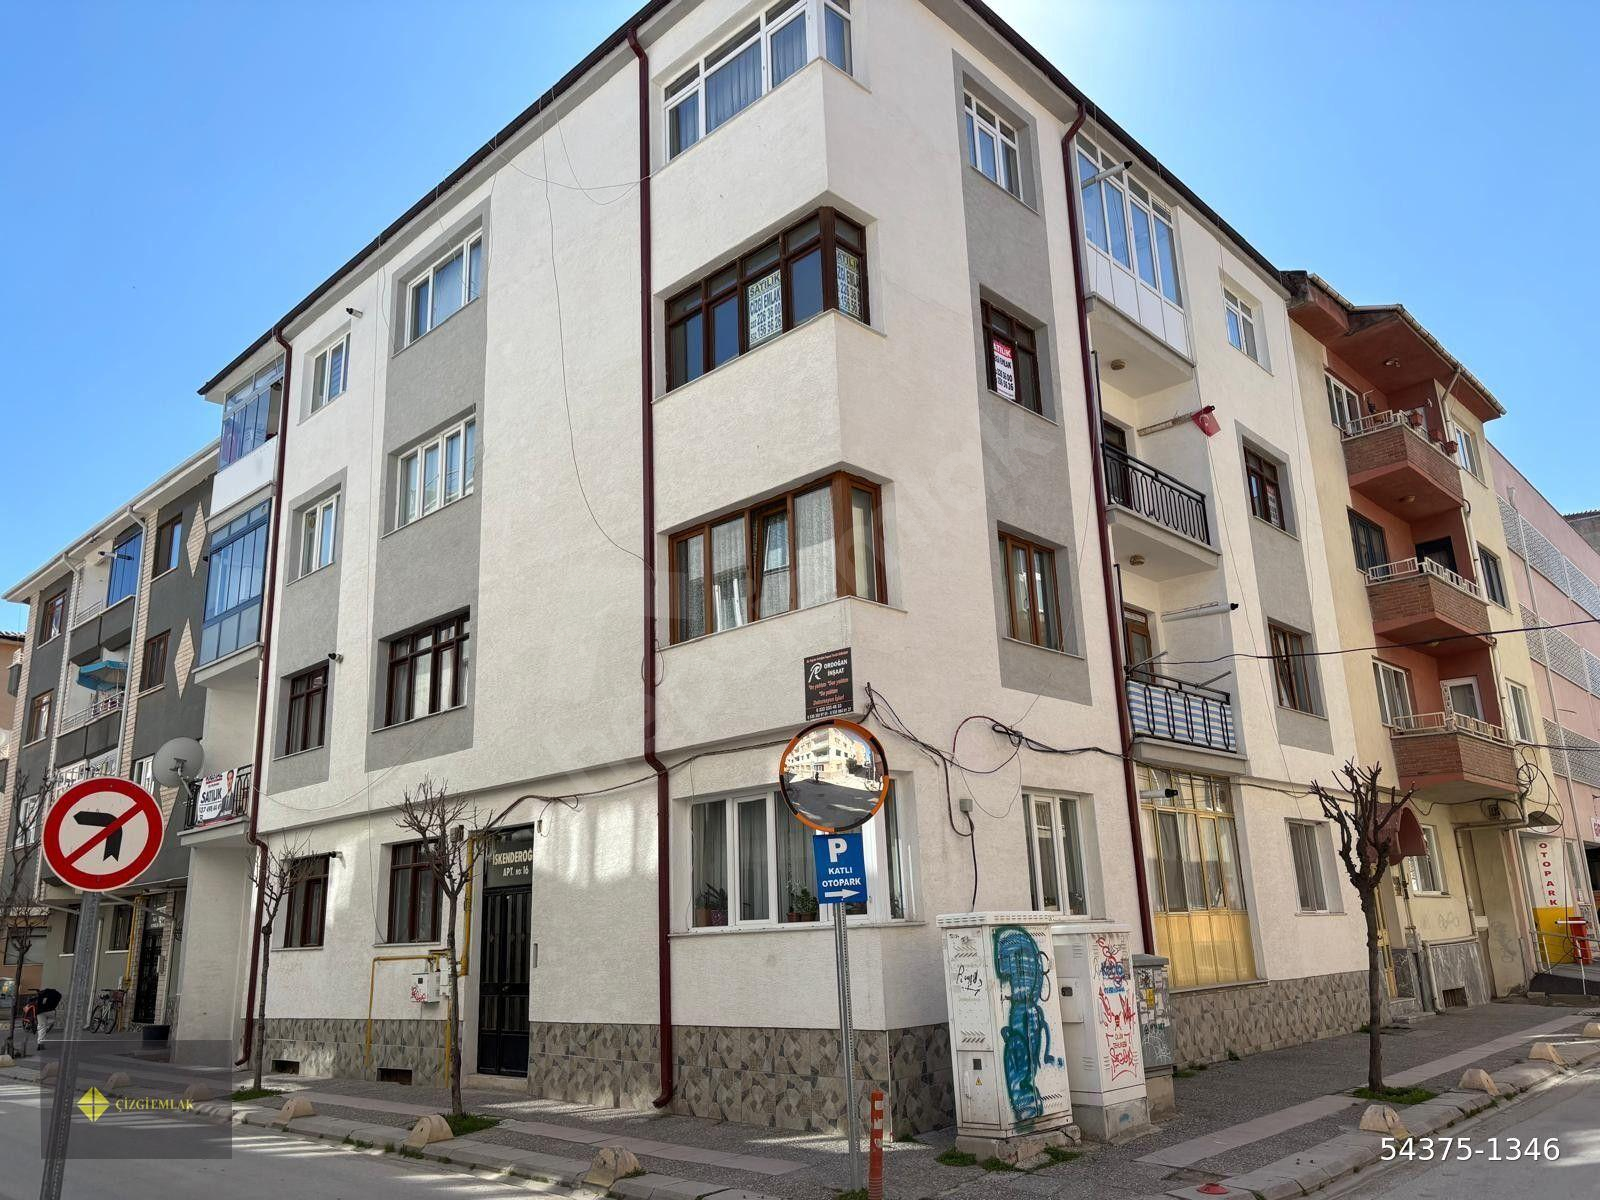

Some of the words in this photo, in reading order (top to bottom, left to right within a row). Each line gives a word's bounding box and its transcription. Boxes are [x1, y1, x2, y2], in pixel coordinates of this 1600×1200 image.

[750, 273, 780, 297] SATILIK
[764, 288, 781, 309] EMLAK
[201, 788, 222, 803] SATILIK
[828, 838, 848, 863] P
[828, 866, 853, 875] KATLI
[1539, 842, 1558, 906] OTOPARK
[822, 877, 861, 887] OTOPARK
